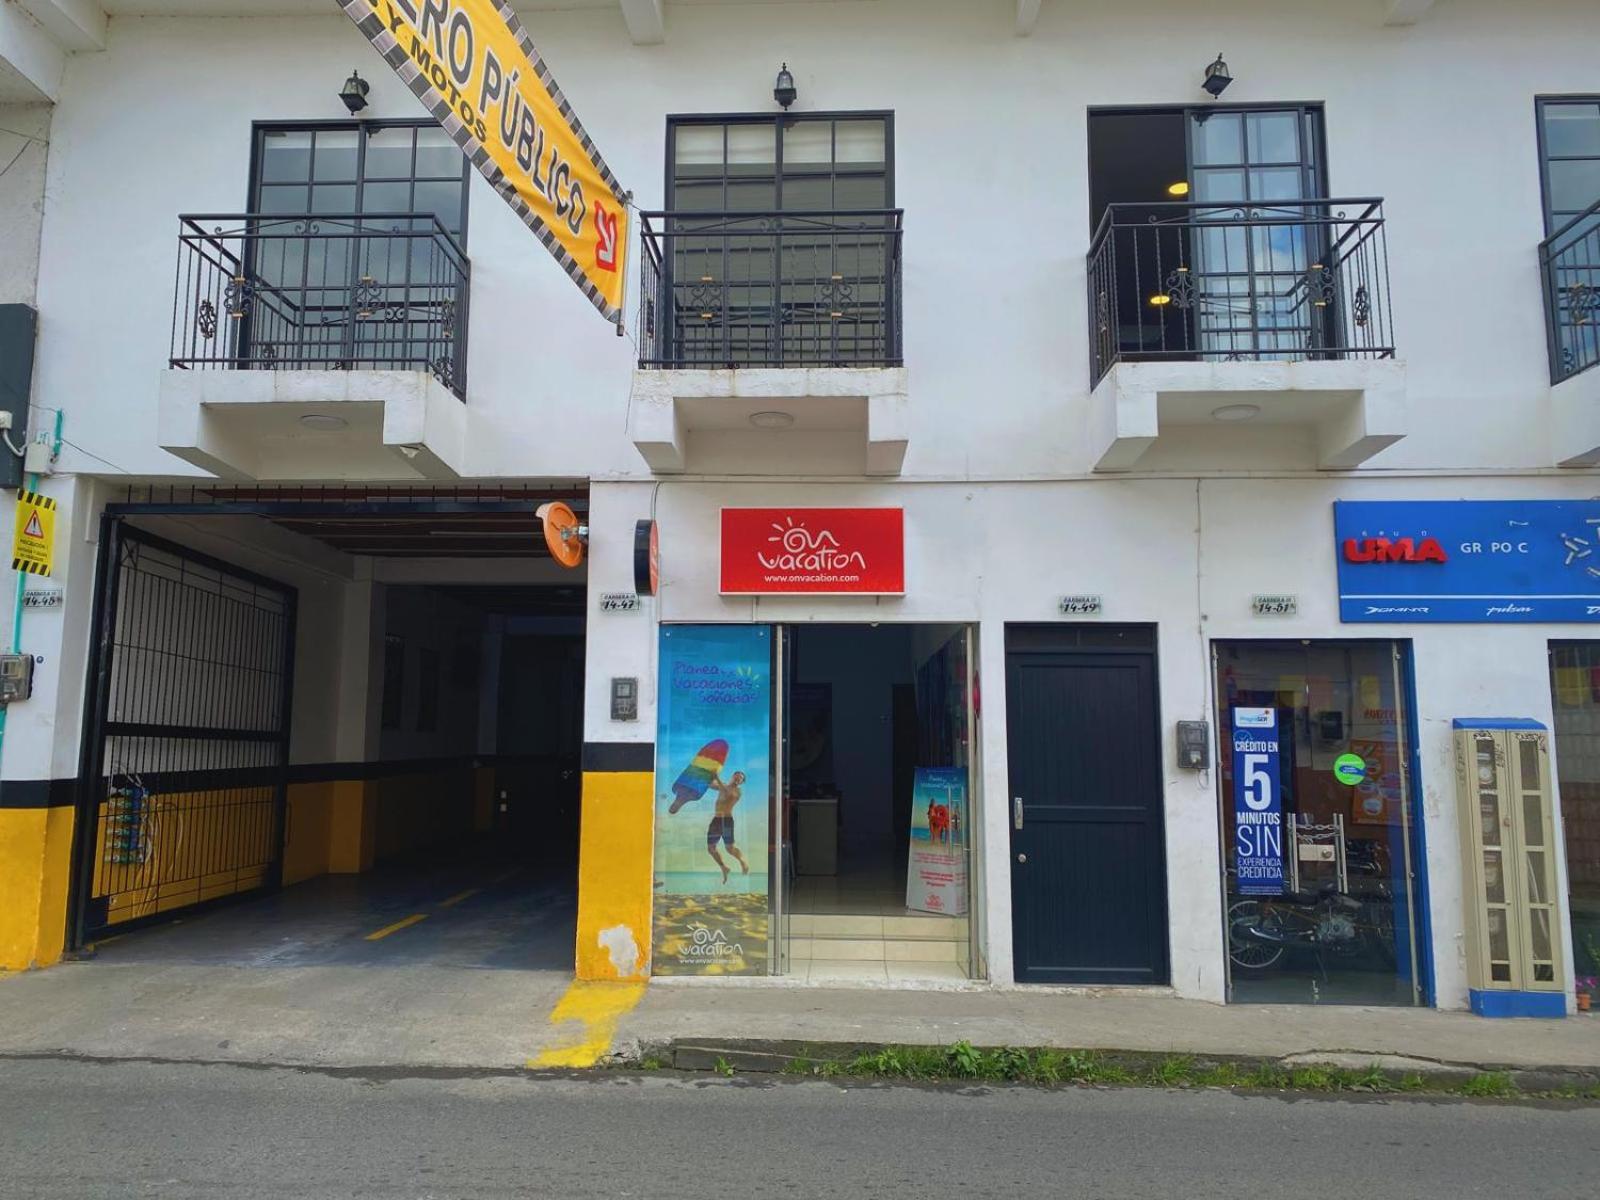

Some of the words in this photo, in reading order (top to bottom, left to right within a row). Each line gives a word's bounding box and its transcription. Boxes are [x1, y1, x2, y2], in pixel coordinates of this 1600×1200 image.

[409, 39, 487, 142] MOTOS
[480, 51, 586, 234] PÚBLICO
[1343, 537, 1448, 562] UMA
[764, 573, 859, 583] www.onvacation.com
[604, 599, 635, 610] 14-47
[1063, 602, 1097, 612] 14-49
[1235, 738, 1267, 752] CRÉDITO
[1268, 741, 1279, 752] EN
[1244, 754, 1272, 811] 5
[1237, 812, 1281, 825] MINUTOS
[1237, 825, 1281, 857] SIN
[1238, 857, 1282, 867] EXPERIENCIA
[1238, 867, 1283, 879] CREDITICIA
